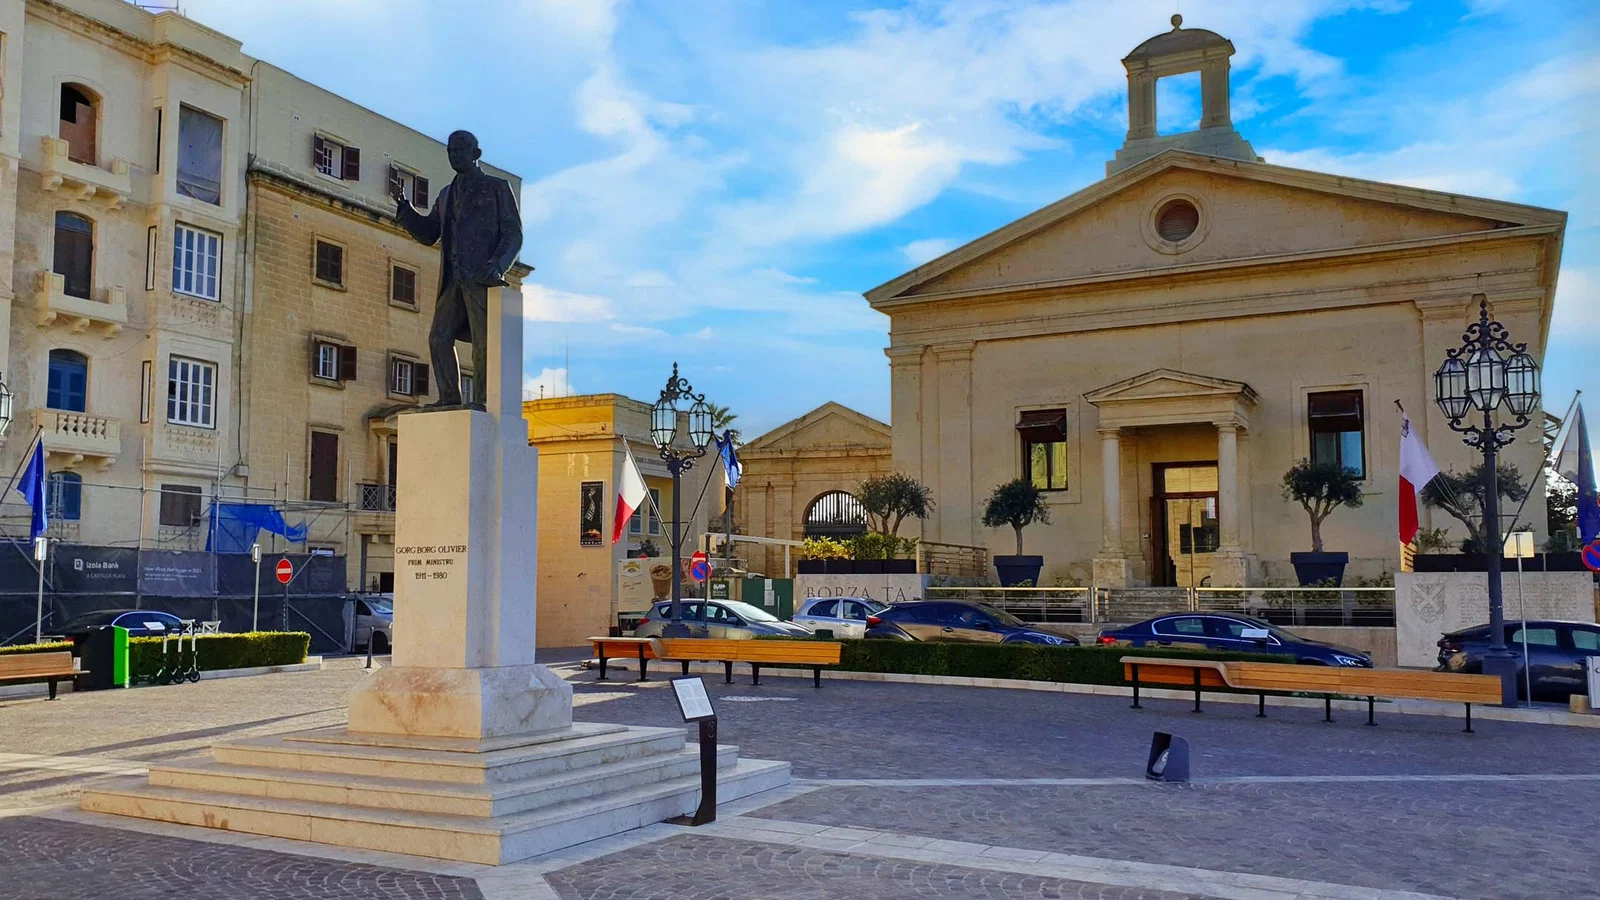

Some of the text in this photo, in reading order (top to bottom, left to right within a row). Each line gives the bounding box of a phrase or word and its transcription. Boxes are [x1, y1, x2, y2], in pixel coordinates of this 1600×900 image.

[416, 546, 436, 554] BORG
[438, 545, 467, 554] OLIVIER
[86, 561, 119, 569] Izola Bank
